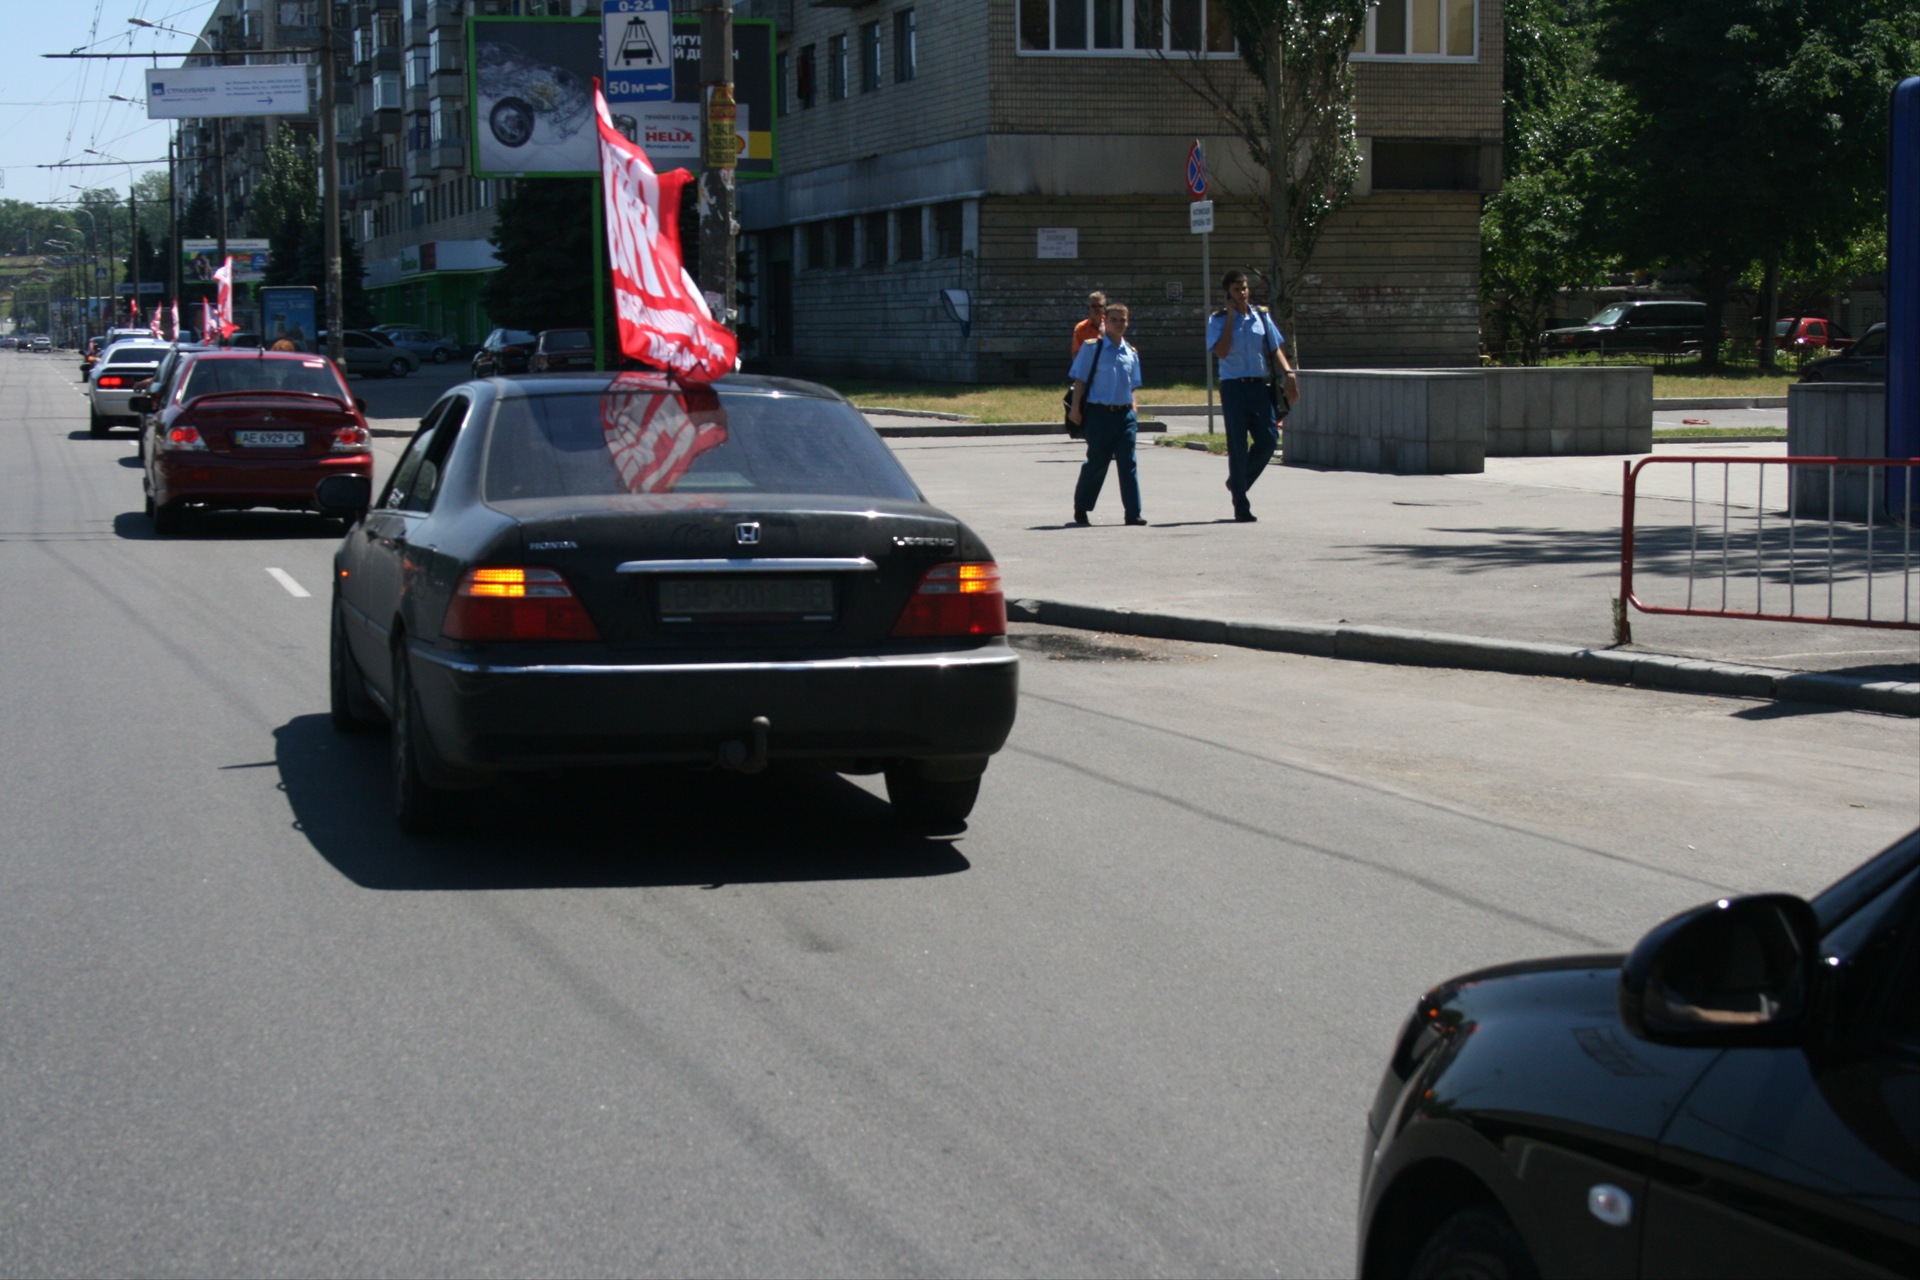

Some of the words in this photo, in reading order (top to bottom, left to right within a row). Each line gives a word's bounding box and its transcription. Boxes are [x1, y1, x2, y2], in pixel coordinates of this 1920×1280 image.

[618, 0, 654, 11] 0-24
[645, 131, 696, 142] HELIX
[529, 541, 579, 550] HONDA
[893, 535, 956, 546] LEGEND
